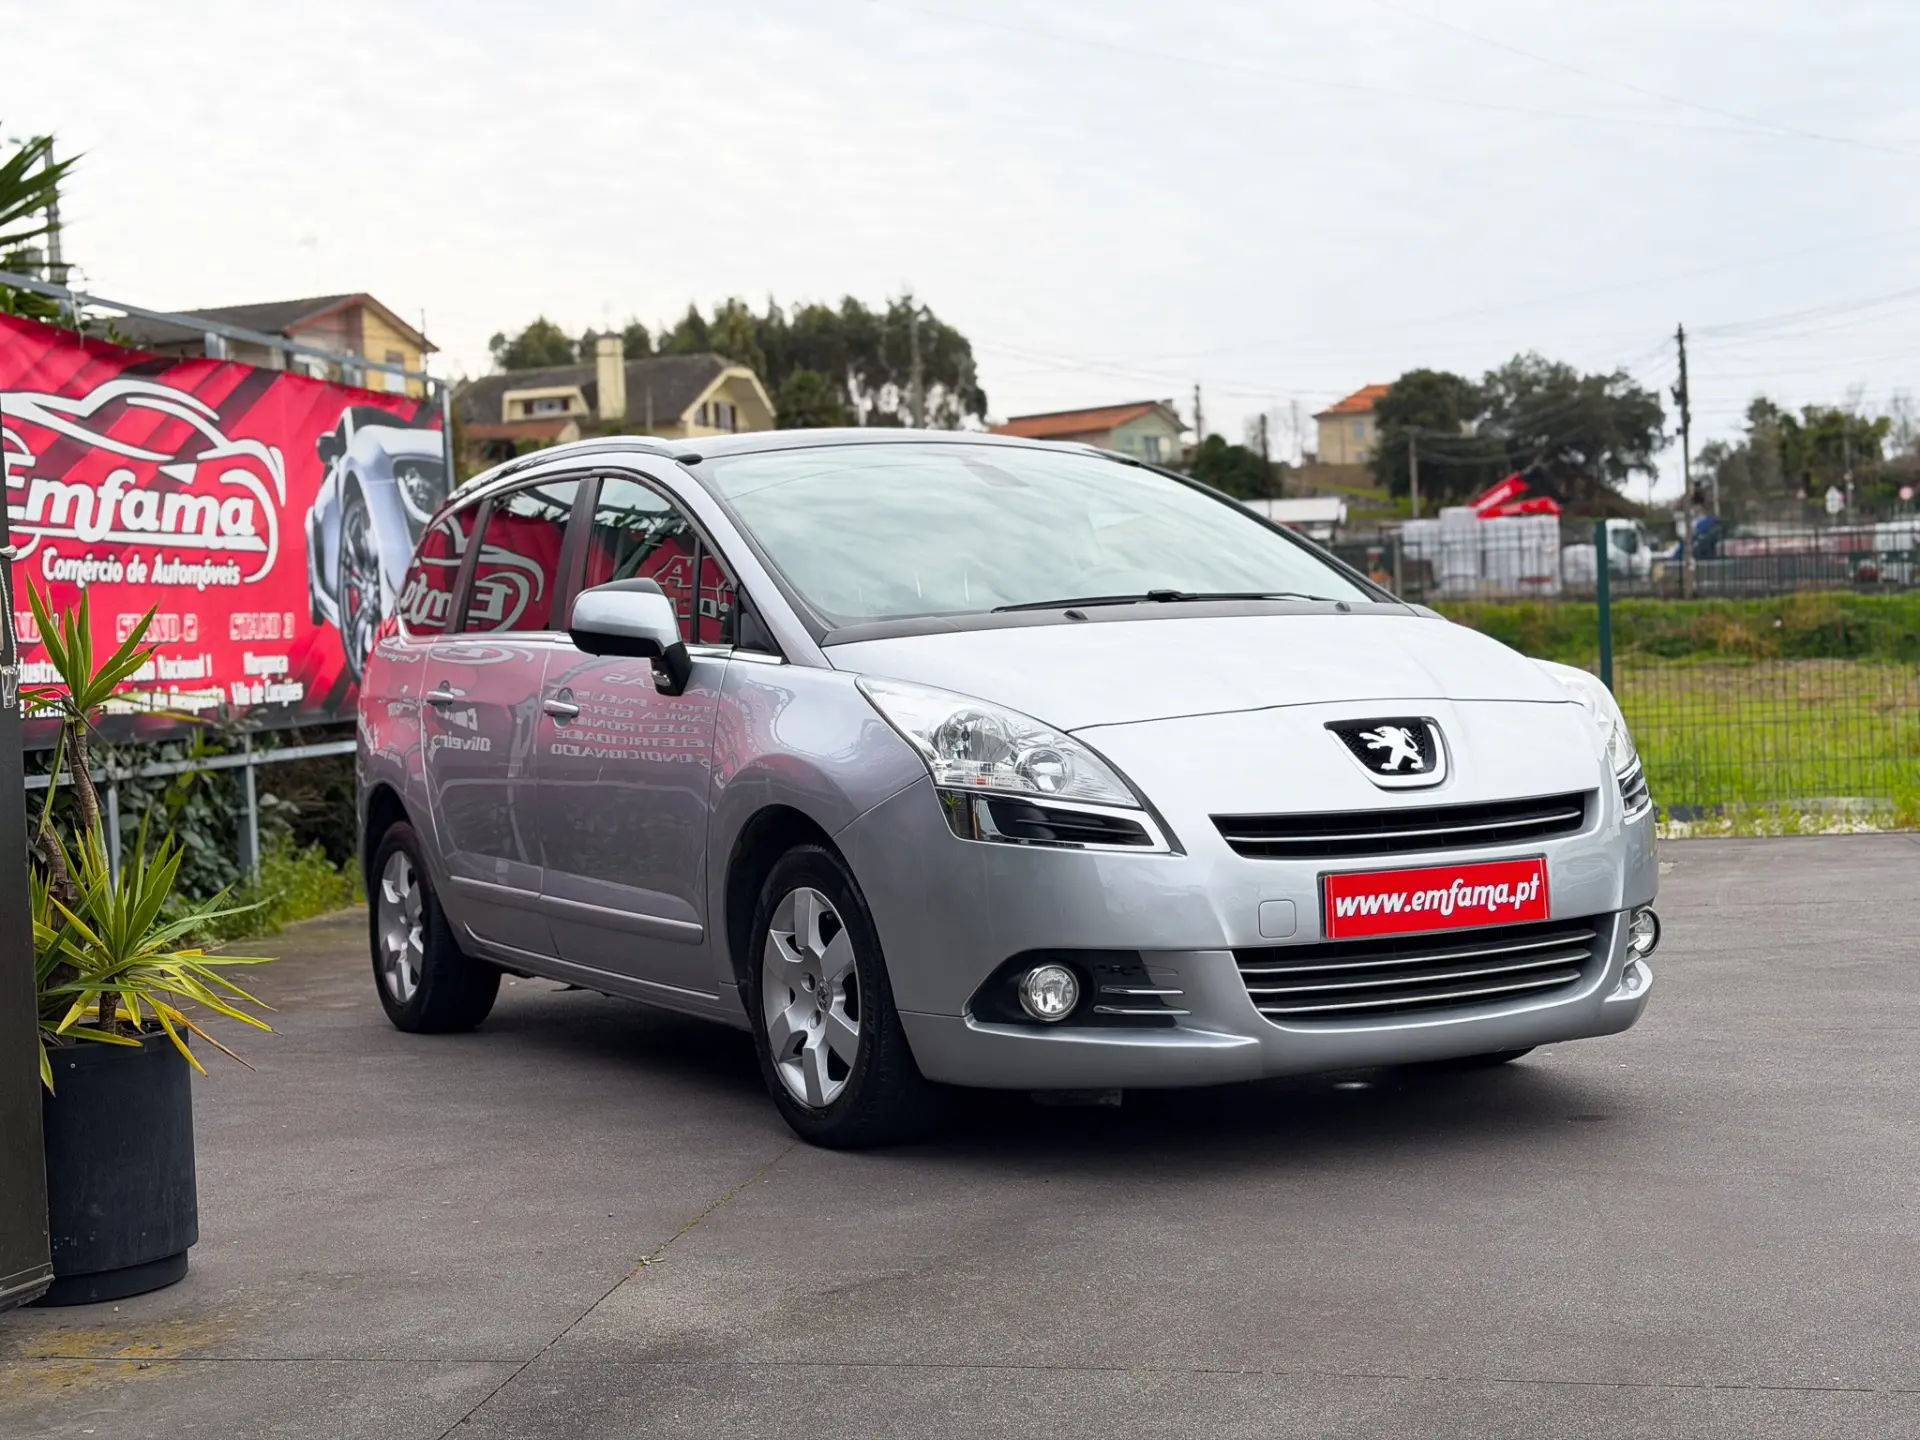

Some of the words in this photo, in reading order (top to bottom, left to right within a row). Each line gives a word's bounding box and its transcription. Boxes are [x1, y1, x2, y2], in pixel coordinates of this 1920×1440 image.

[4, 452, 257, 549] Emfama
[42, 547, 123, 588] Comércio
[126, 554, 148, 583] de
[151, 553, 241, 591] Automóveis
[1335, 872, 1541, 917] www.emfama.pt
